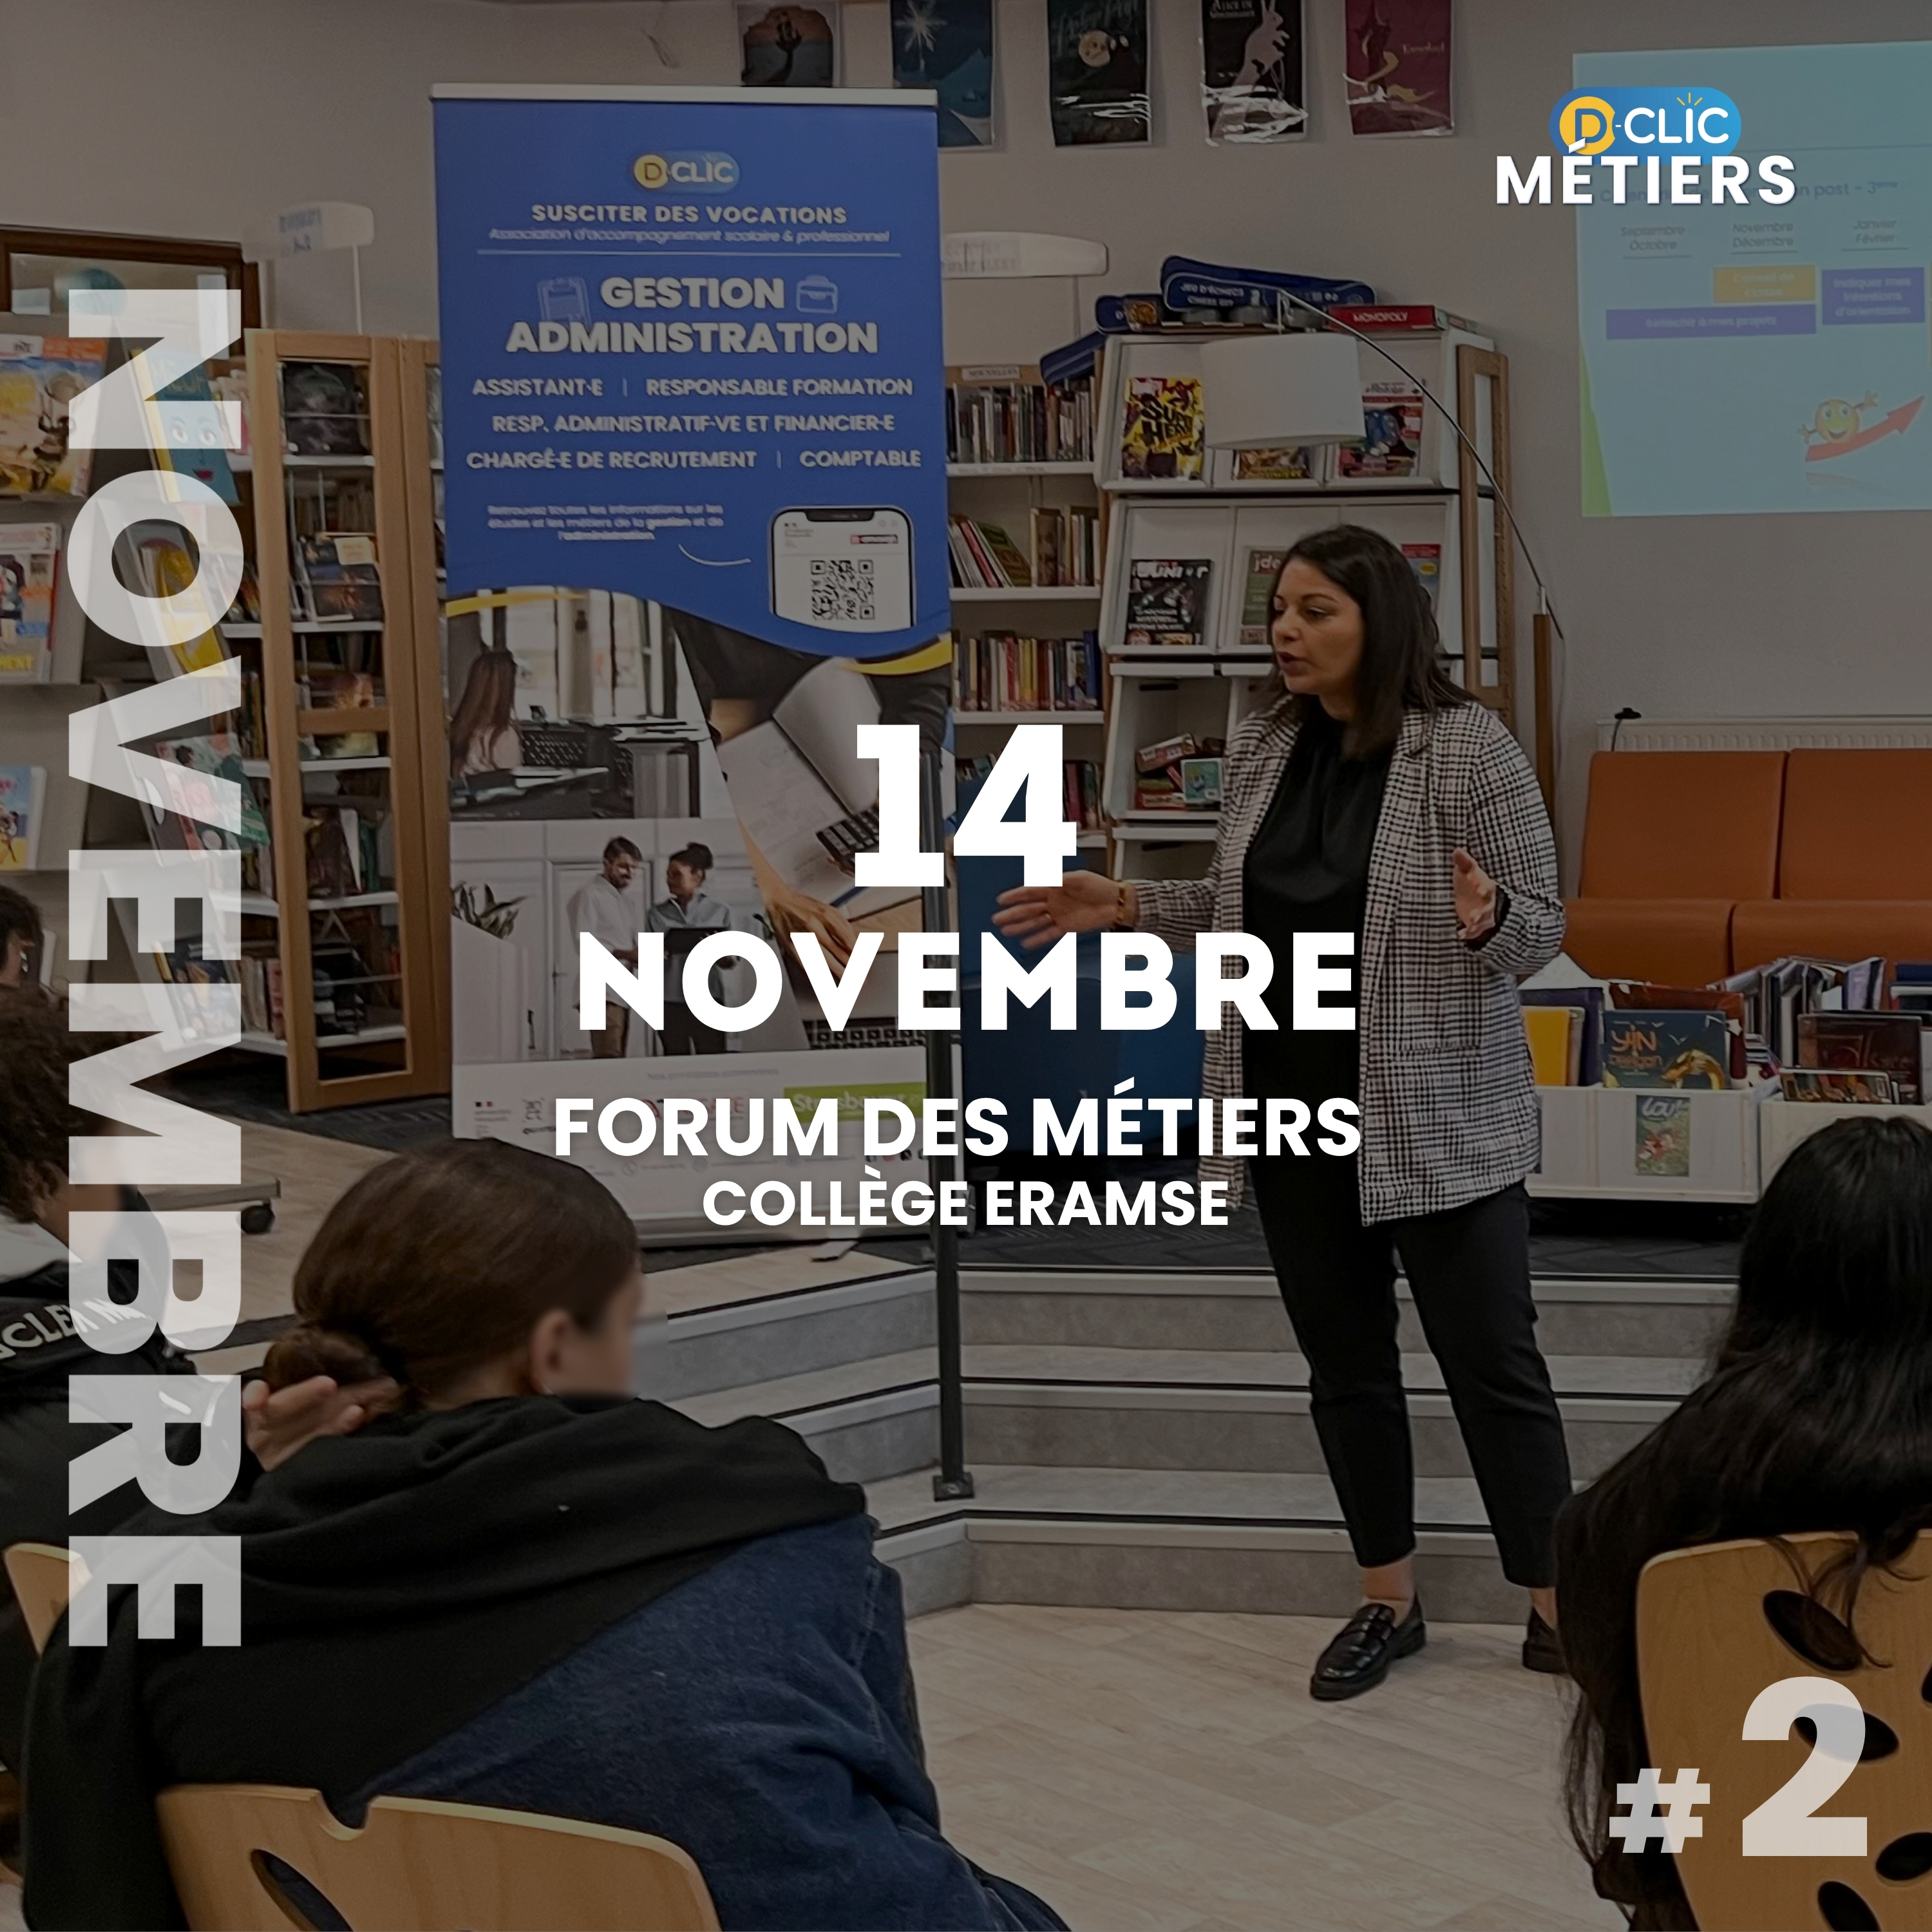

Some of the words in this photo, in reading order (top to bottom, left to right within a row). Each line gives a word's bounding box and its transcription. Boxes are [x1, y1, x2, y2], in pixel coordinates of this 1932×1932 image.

[1814, 183, 1850, 200] post
[533, 205, 647, 222] SUSCITER
[656, 206, 698, 222] DES
[707, 207, 846, 223] VOCATIONS
[782, 230, 793, 243] &
[796, 230, 890, 245] professionnel
[601, 278, 784, 308] GESTION
[1353, 311, 1408, 323] MONOPOLY
[507, 322, 877, 352] ADMINISTRATION
[647, 379, 787, 395] RESPONSABLE
[793, 379, 912, 395] FORMATION
[746, 416, 768, 431] ET
[578, 452, 603, 468] DE
[610, 451, 756, 468] RECRUTEMENT
[800, 451, 920, 467] COMPTABLE
